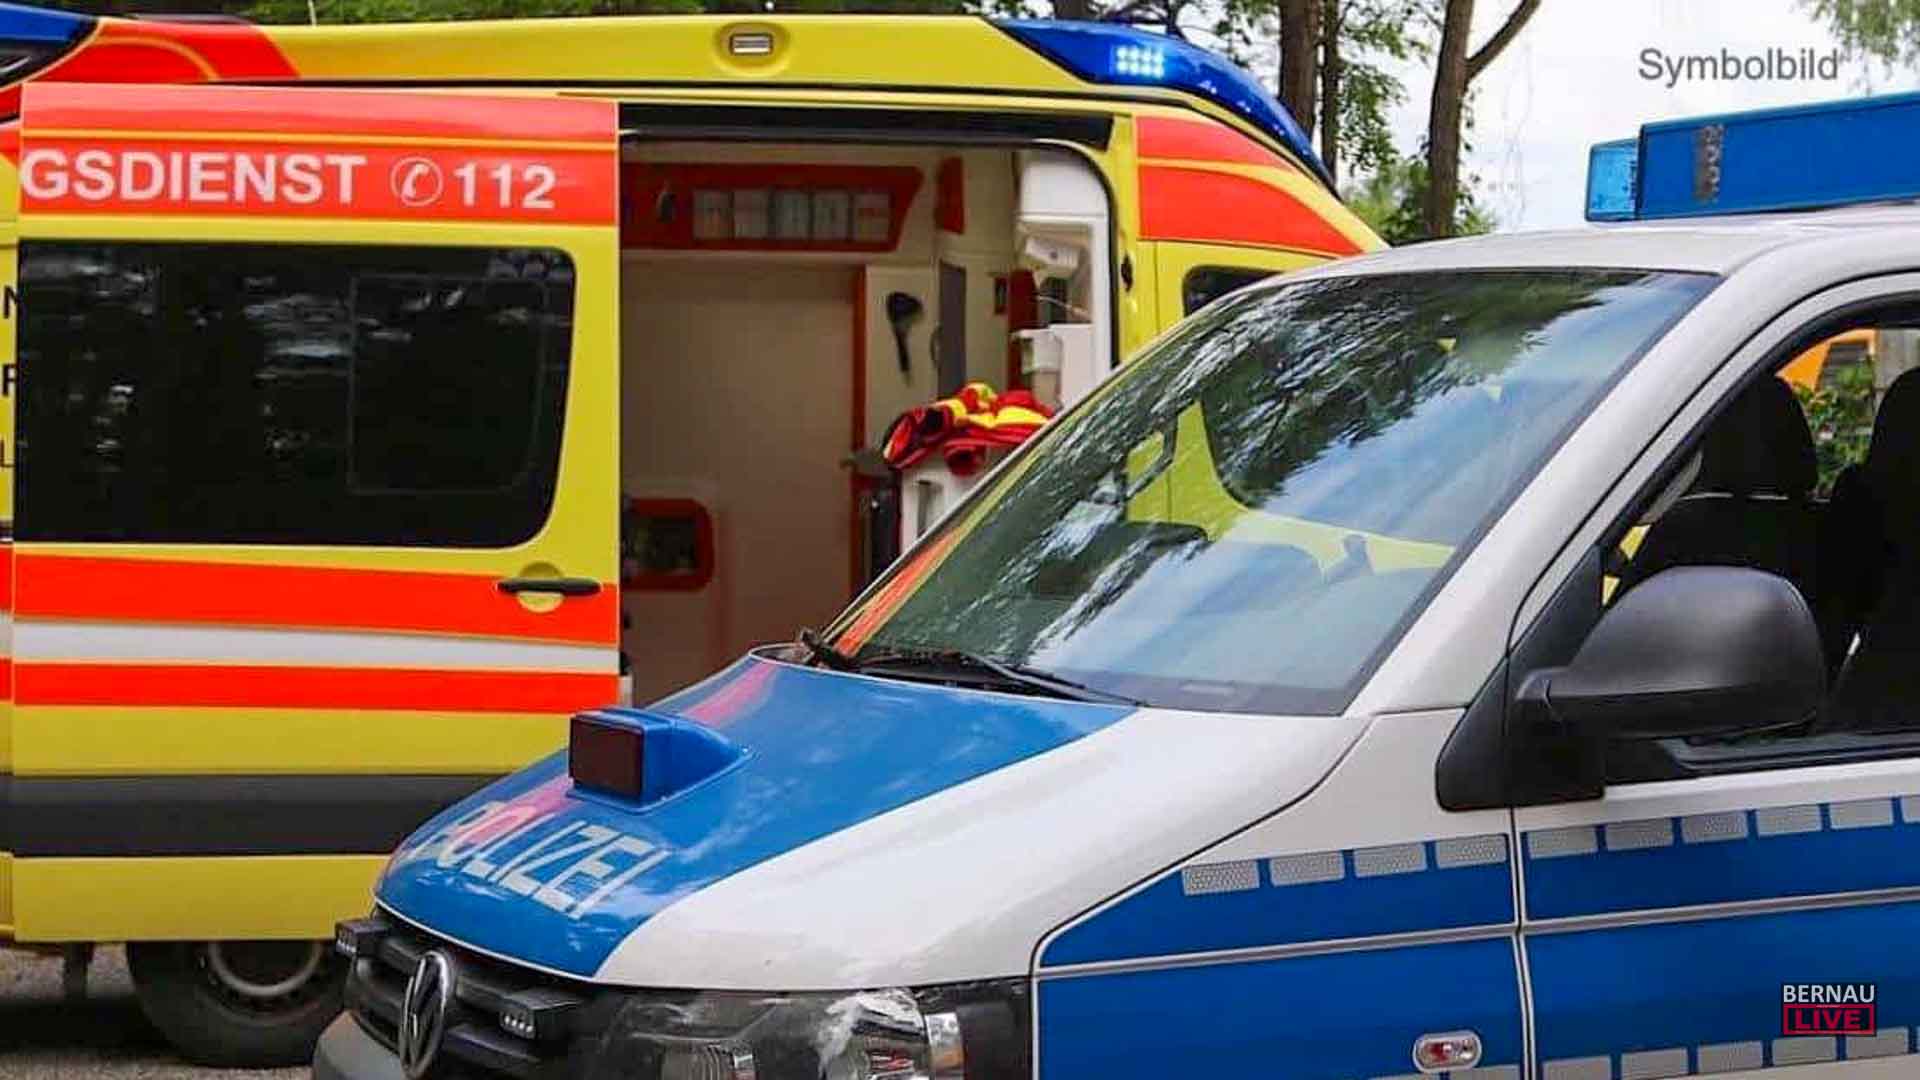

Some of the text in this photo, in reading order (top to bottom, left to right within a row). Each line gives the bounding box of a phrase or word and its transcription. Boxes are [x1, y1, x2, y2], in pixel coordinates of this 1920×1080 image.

[20, 149, 556, 209] GSDIENST 112
[400, 802, 673, 919] POLIZEI
